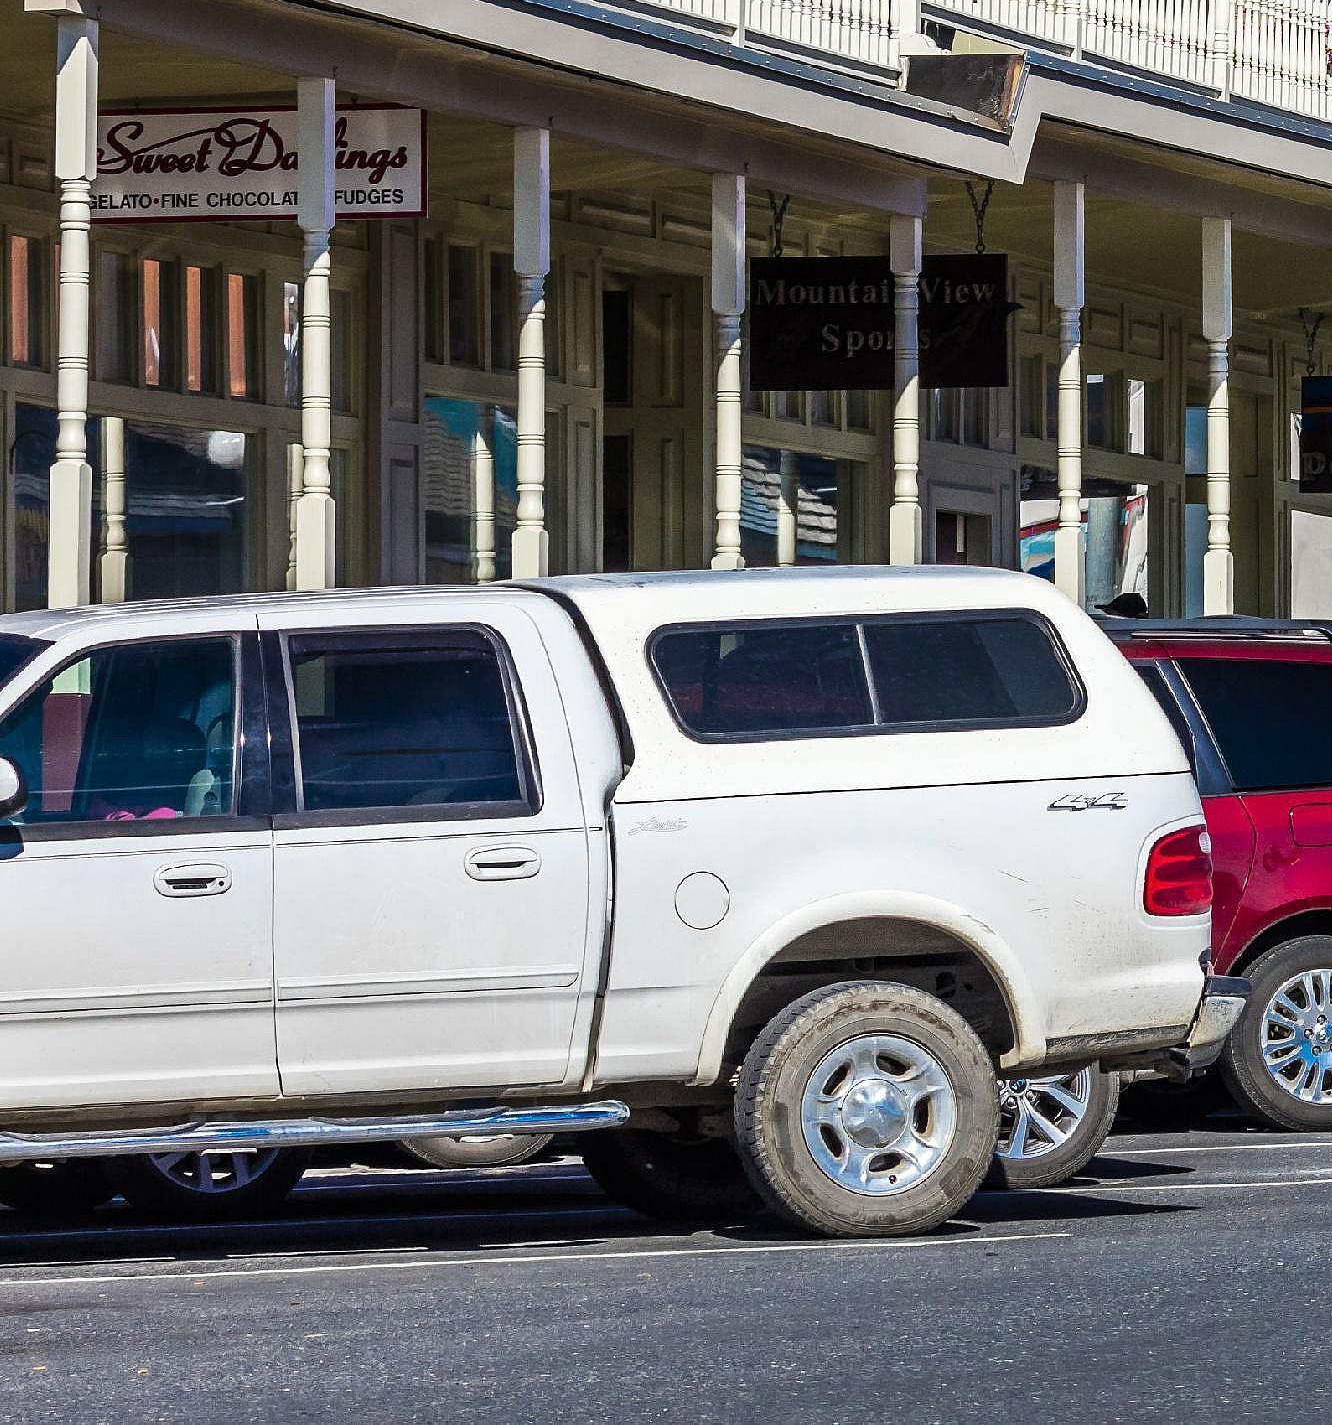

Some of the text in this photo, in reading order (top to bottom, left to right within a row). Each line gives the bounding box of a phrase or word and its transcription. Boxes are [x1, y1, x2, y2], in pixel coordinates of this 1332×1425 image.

[97, 118, 408, 184] Sweet Daings
[161, 193, 199, 208] FINE
[206, 191, 299, 207] CHOCOLAT
[335, 189, 404, 205] FUDGES
[757, 276, 996, 305] Mountai View
